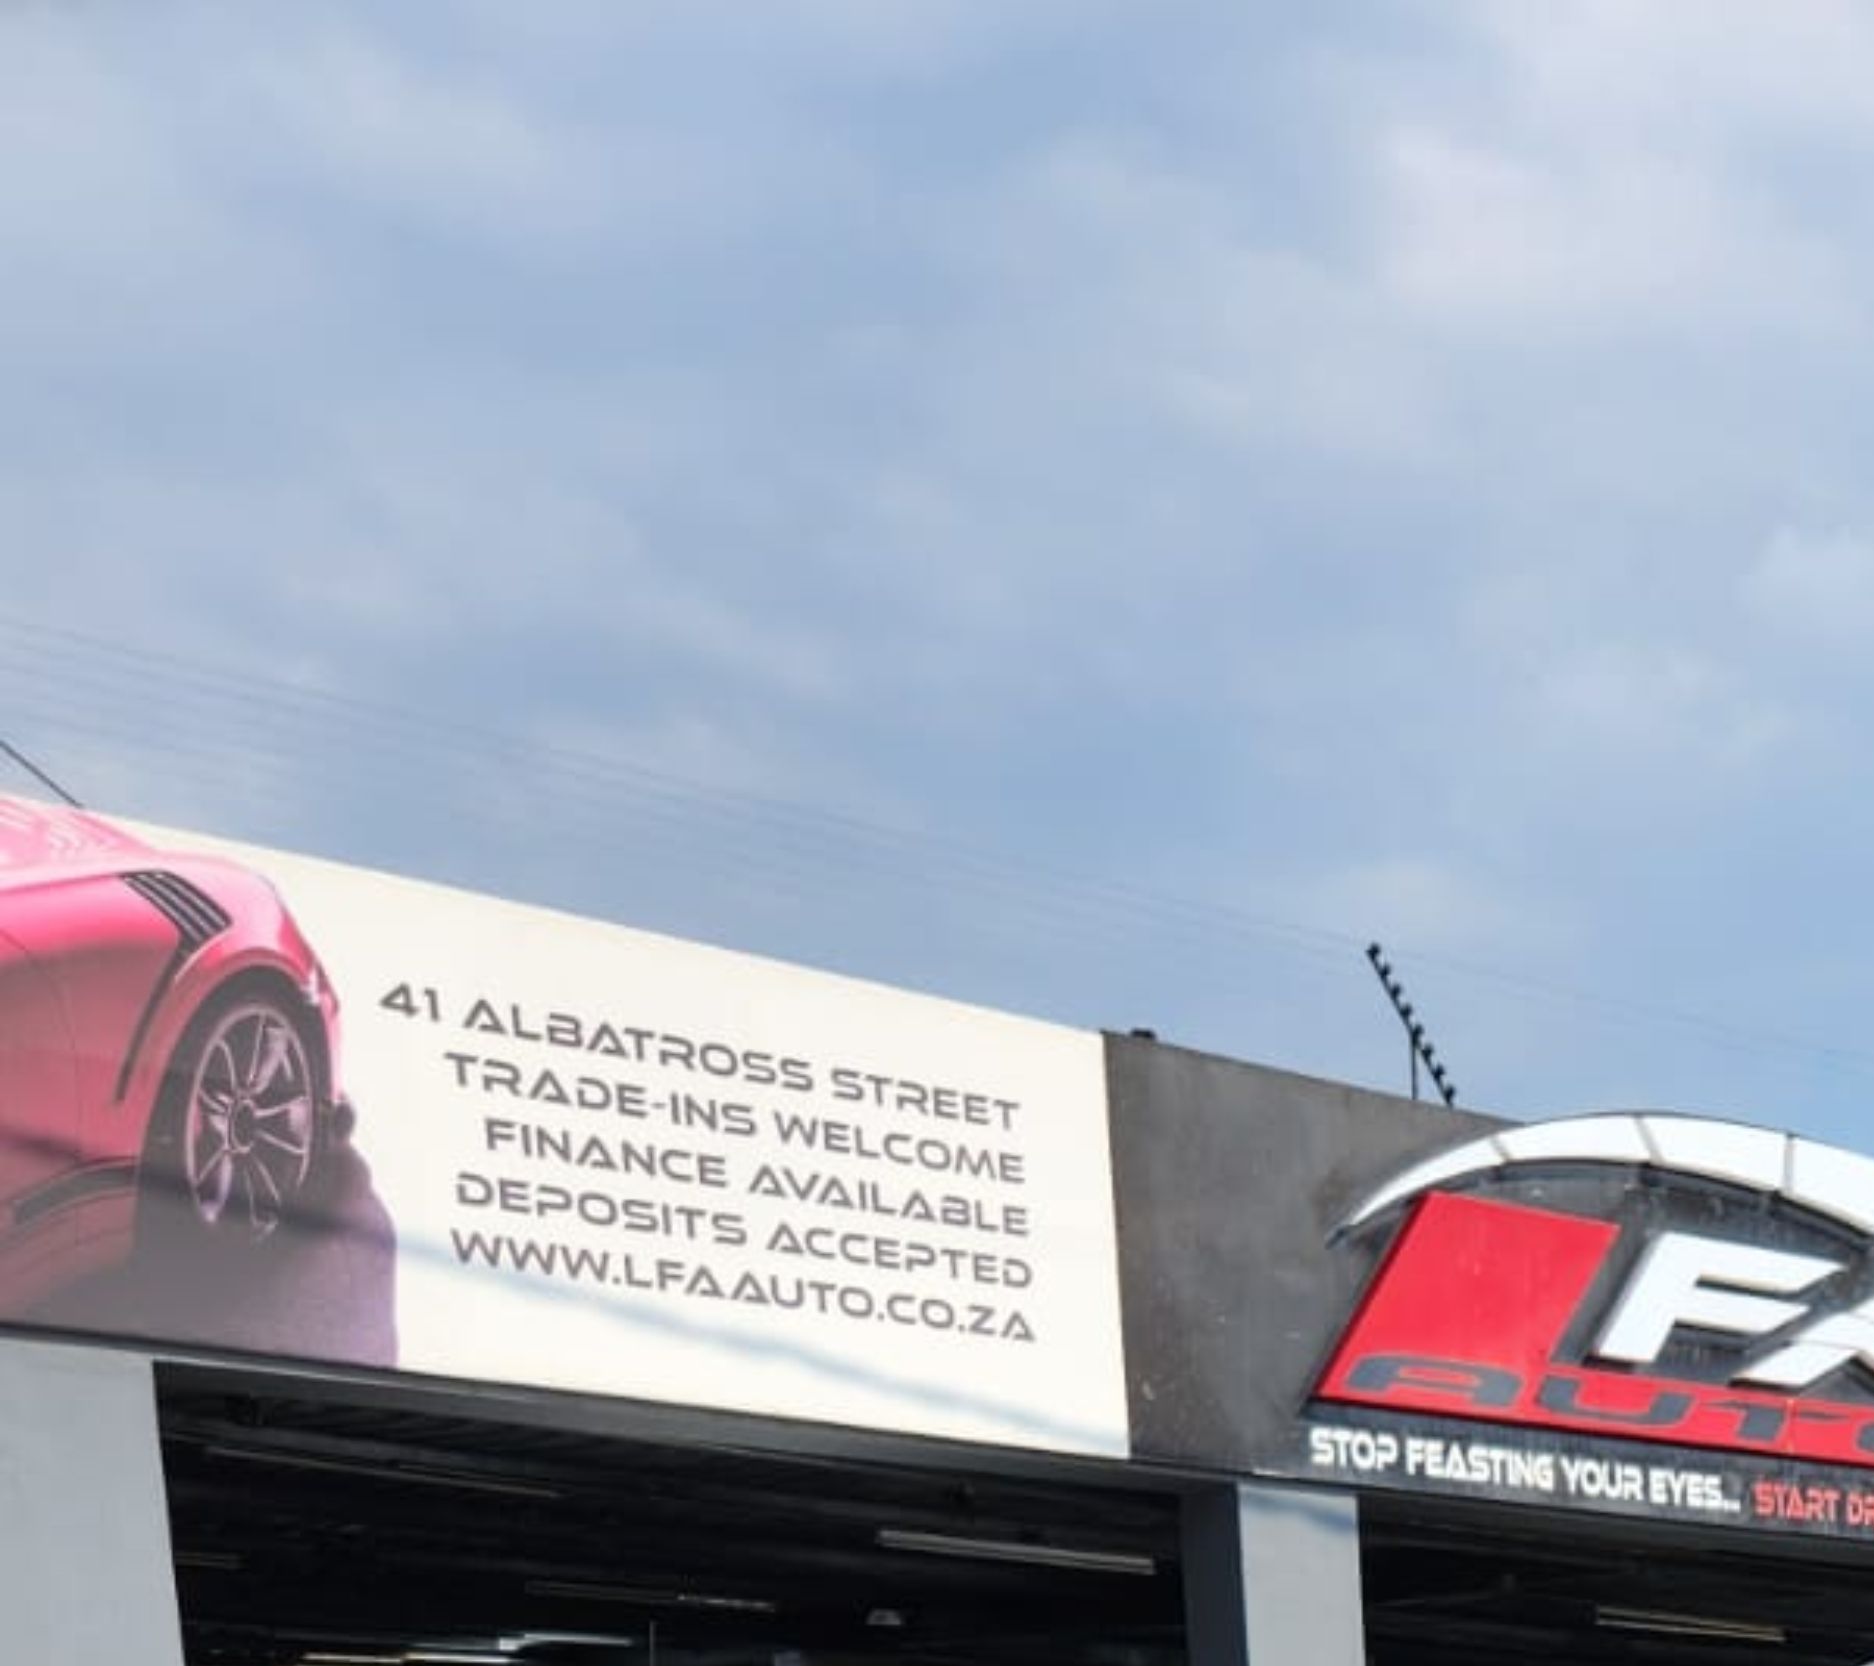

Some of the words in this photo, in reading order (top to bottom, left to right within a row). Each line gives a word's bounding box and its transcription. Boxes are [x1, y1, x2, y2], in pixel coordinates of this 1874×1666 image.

[379, 981, 440, 1022] 41
[462, 998, 814, 1092] ALBATROSS
[830, 1067, 1020, 1131] STREET
[444, 1051, 758, 1137] TRADE-INS
[773, 1110, 1026, 1184] WELCOME
[484, 1117, 728, 1188] FINANCE
[749, 1163, 1030, 1236] AVAILABLE
[450, 1228, 1035, 1342] WWW.LFAAUTO.CO.ZA
[456, 1171, 748, 1246] DEPOSITS
[765, 1221, 1033, 1289] ACCEPTED
[1309, 1425, 1399, 1471] STOP
[1404, 1434, 1556, 1492] FEASTING
[1560, 1457, 1644, 1497] YOUR
[1752, 1479, 1841, 1522] START
